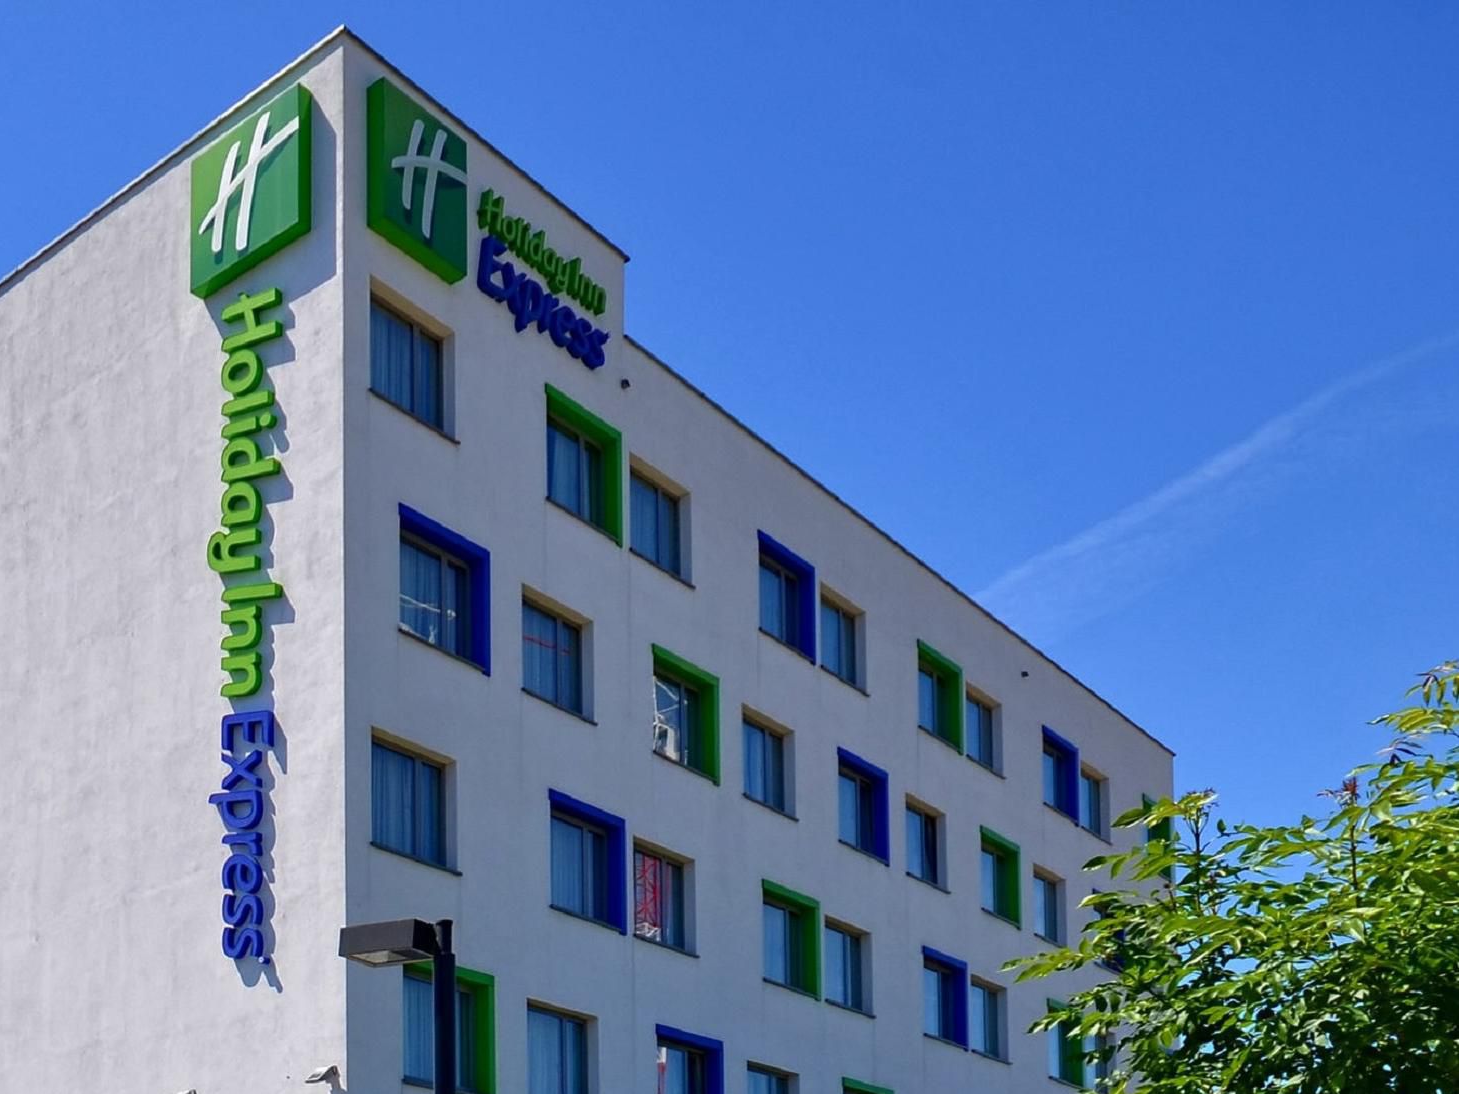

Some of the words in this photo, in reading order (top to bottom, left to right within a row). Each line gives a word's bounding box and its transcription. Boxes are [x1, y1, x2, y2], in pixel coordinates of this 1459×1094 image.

[198, 111, 299, 253] H
[391, 119, 467, 239] H
[477, 188, 568, 294] Holiday
[566, 258, 607, 316] Inn
[477, 235, 607, 370] Express
[207, 288, 283, 573] Holiday
[221, 582, 283, 698] Inn
[208, 710, 274, 959] Express
